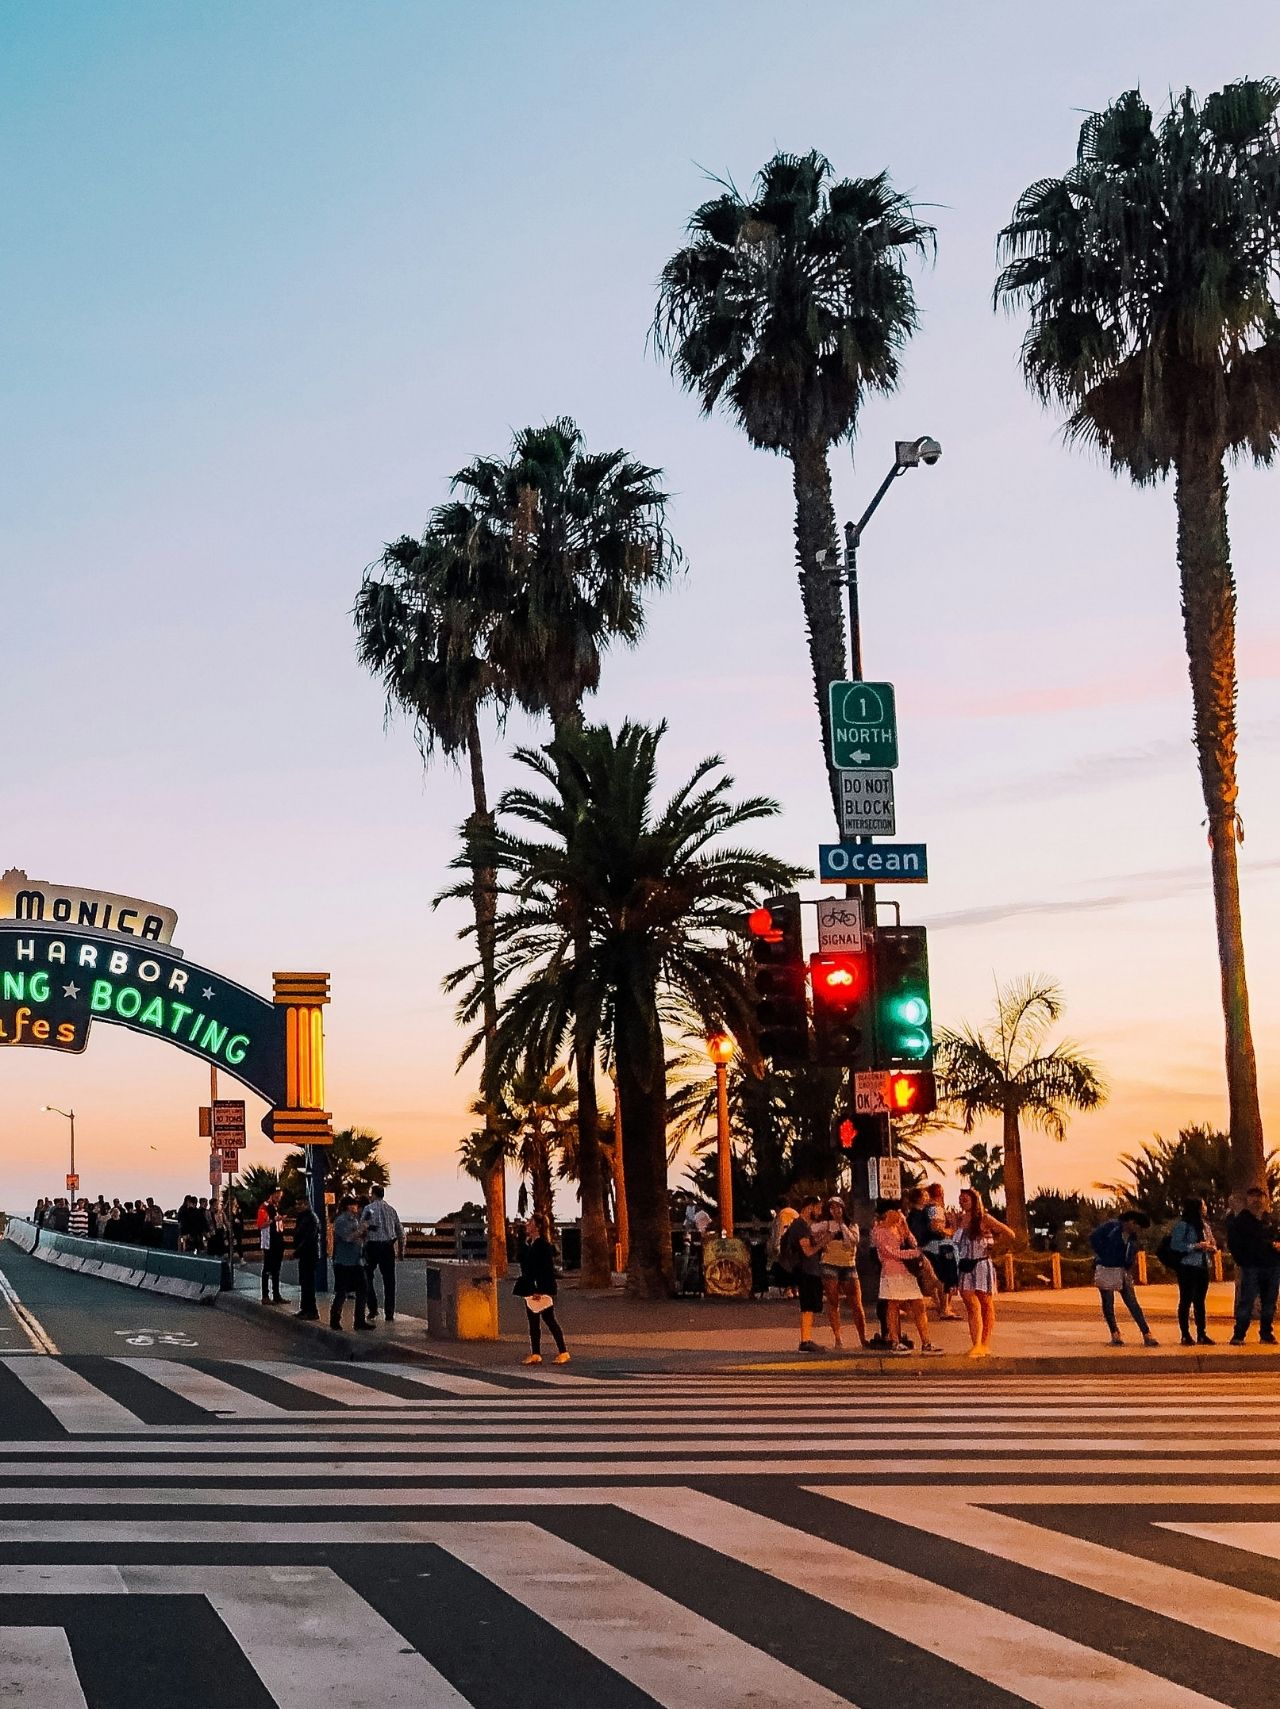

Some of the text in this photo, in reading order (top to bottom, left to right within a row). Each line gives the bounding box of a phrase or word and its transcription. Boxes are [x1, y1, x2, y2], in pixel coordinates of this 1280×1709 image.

[859, 698, 866, 717] 1
[836, 728, 892, 743] NORTH
[844, 779, 890, 794] DO NOT
[845, 800, 891, 815] BLOCK
[845, 819, 892, 830] INTERSECTION
[828, 848, 919, 871] Ocean
[15, 890, 165, 942] MONICA
[821, 934, 860, 946] SIGNAL
[16, 939, 190, 994] HARBOR
[90, 979, 251, 1065] BOATING
[857, 1093, 870, 1110] OK
